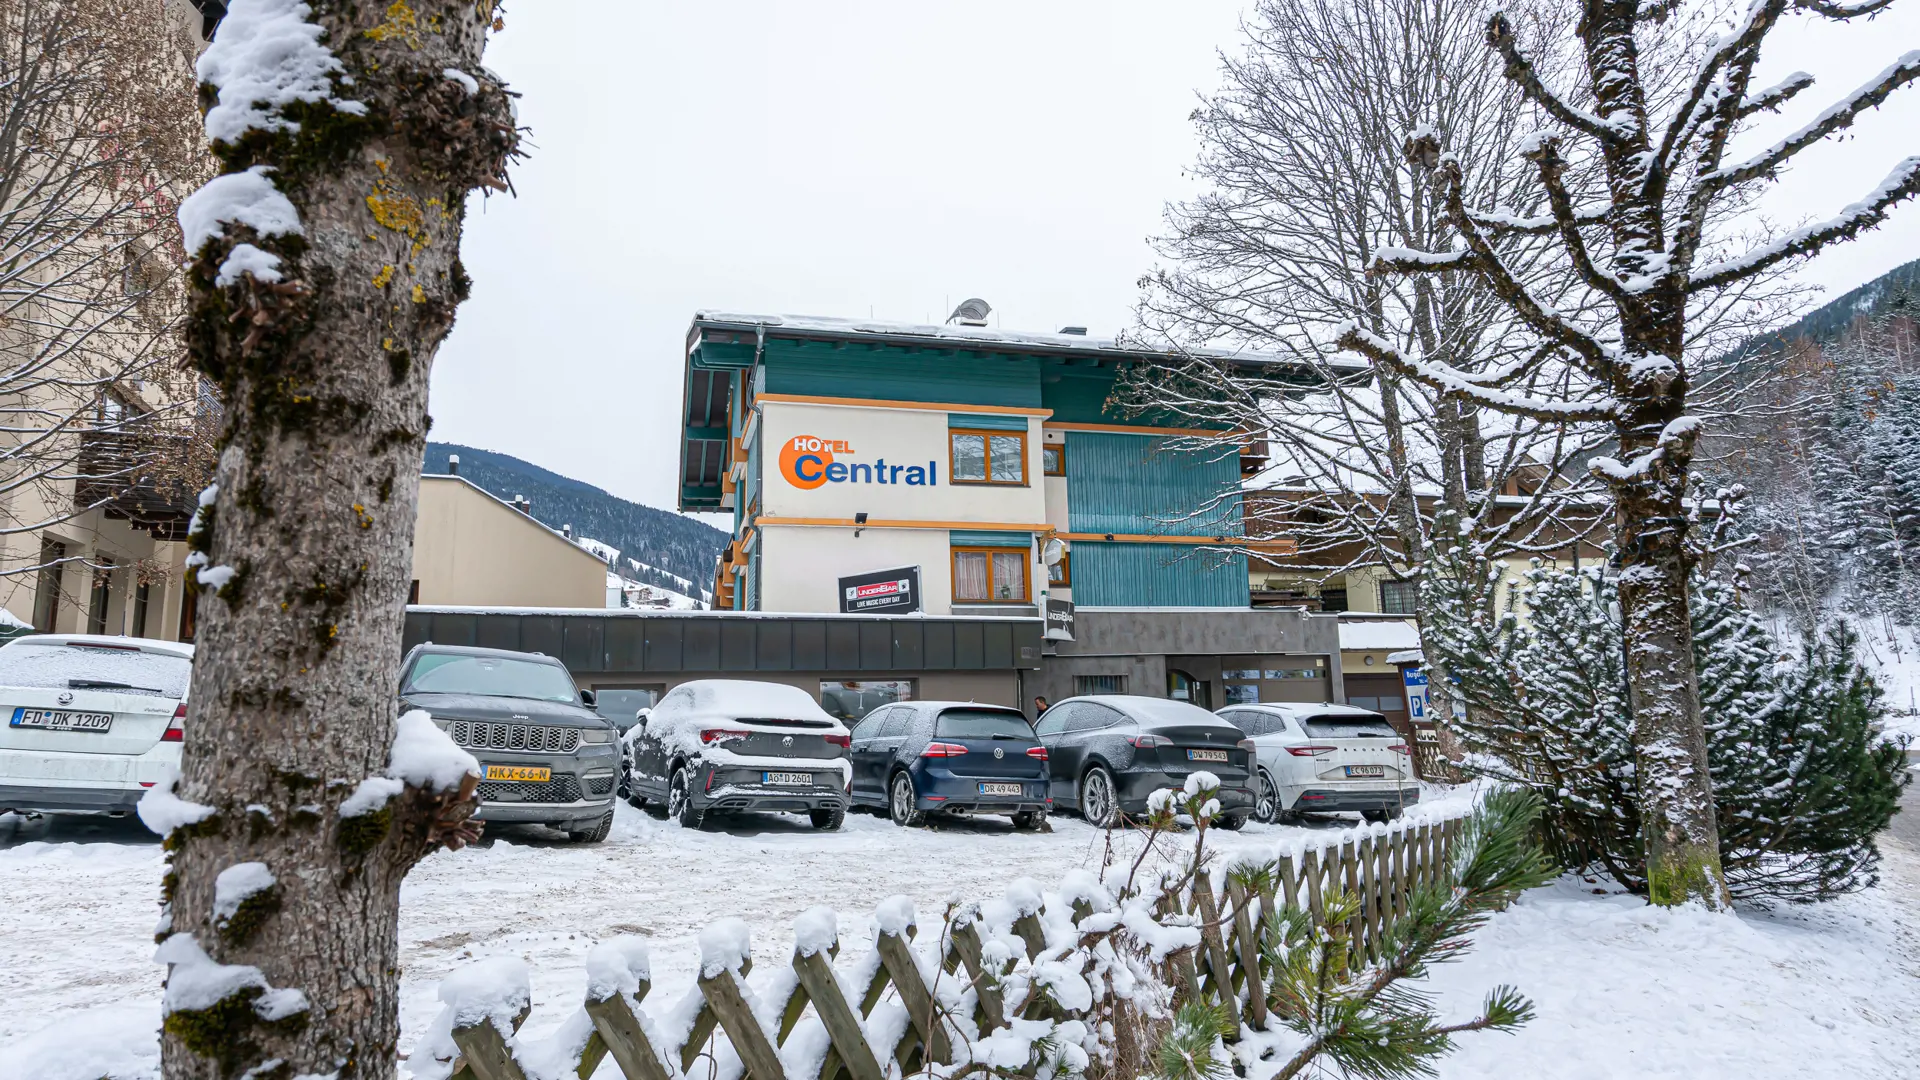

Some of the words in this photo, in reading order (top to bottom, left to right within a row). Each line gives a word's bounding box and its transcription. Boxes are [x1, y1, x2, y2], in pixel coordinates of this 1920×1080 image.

[794, 438, 855, 454] HOTEL
[794, 454, 937, 486] Central
[856, 600, 866, 608] LIVE
[866, 599, 879, 607] MUSIC
[879, 597, 892, 605] EVERY
[1412, 697, 1420, 715] P
[21, 711, 43, 725] FD
[51, 712, 72, 726] DK
[73, 714, 110, 728] 1209
[489, 767, 548, 779] HKX-66-N
[784, 773, 790, 783] D
[792, 774, 812, 783] 2601
[984, 784, 995, 793] DR
[997, 785, 1006, 794] 49
[1007, 785, 1020, 793] 443
